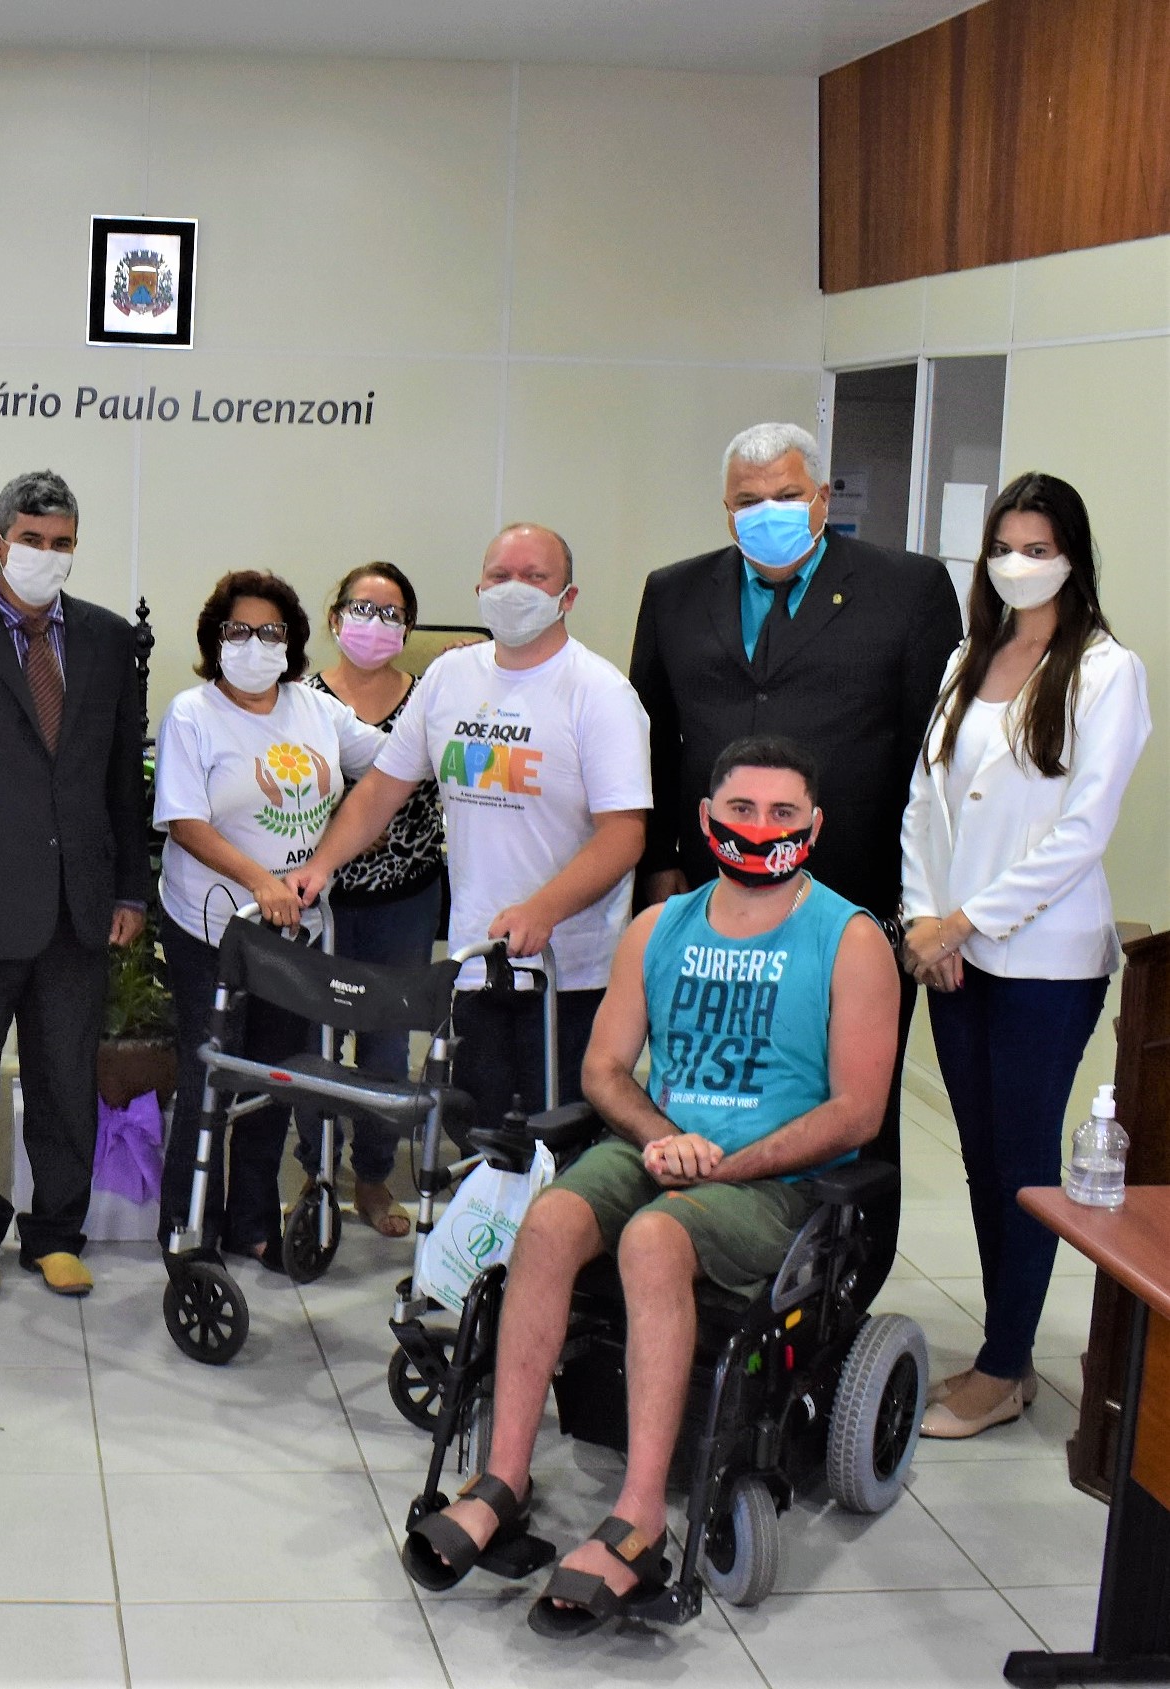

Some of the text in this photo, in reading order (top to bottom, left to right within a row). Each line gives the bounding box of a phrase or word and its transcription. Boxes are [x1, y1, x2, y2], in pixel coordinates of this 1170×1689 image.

[75, 385, 180, 422] Paulo
[192, 389, 375, 425] Lorenzoni
[455, 720, 488, 738] DOE
[488, 724, 531, 742] AQUI
[439, 740, 543, 796] APAE
[681, 945, 788, 982] SURFER'S
[668, 975, 779, 1037] PARA
[697, 1094, 711, 1105] THE
[737, 1097, 760, 1109] VIBES
